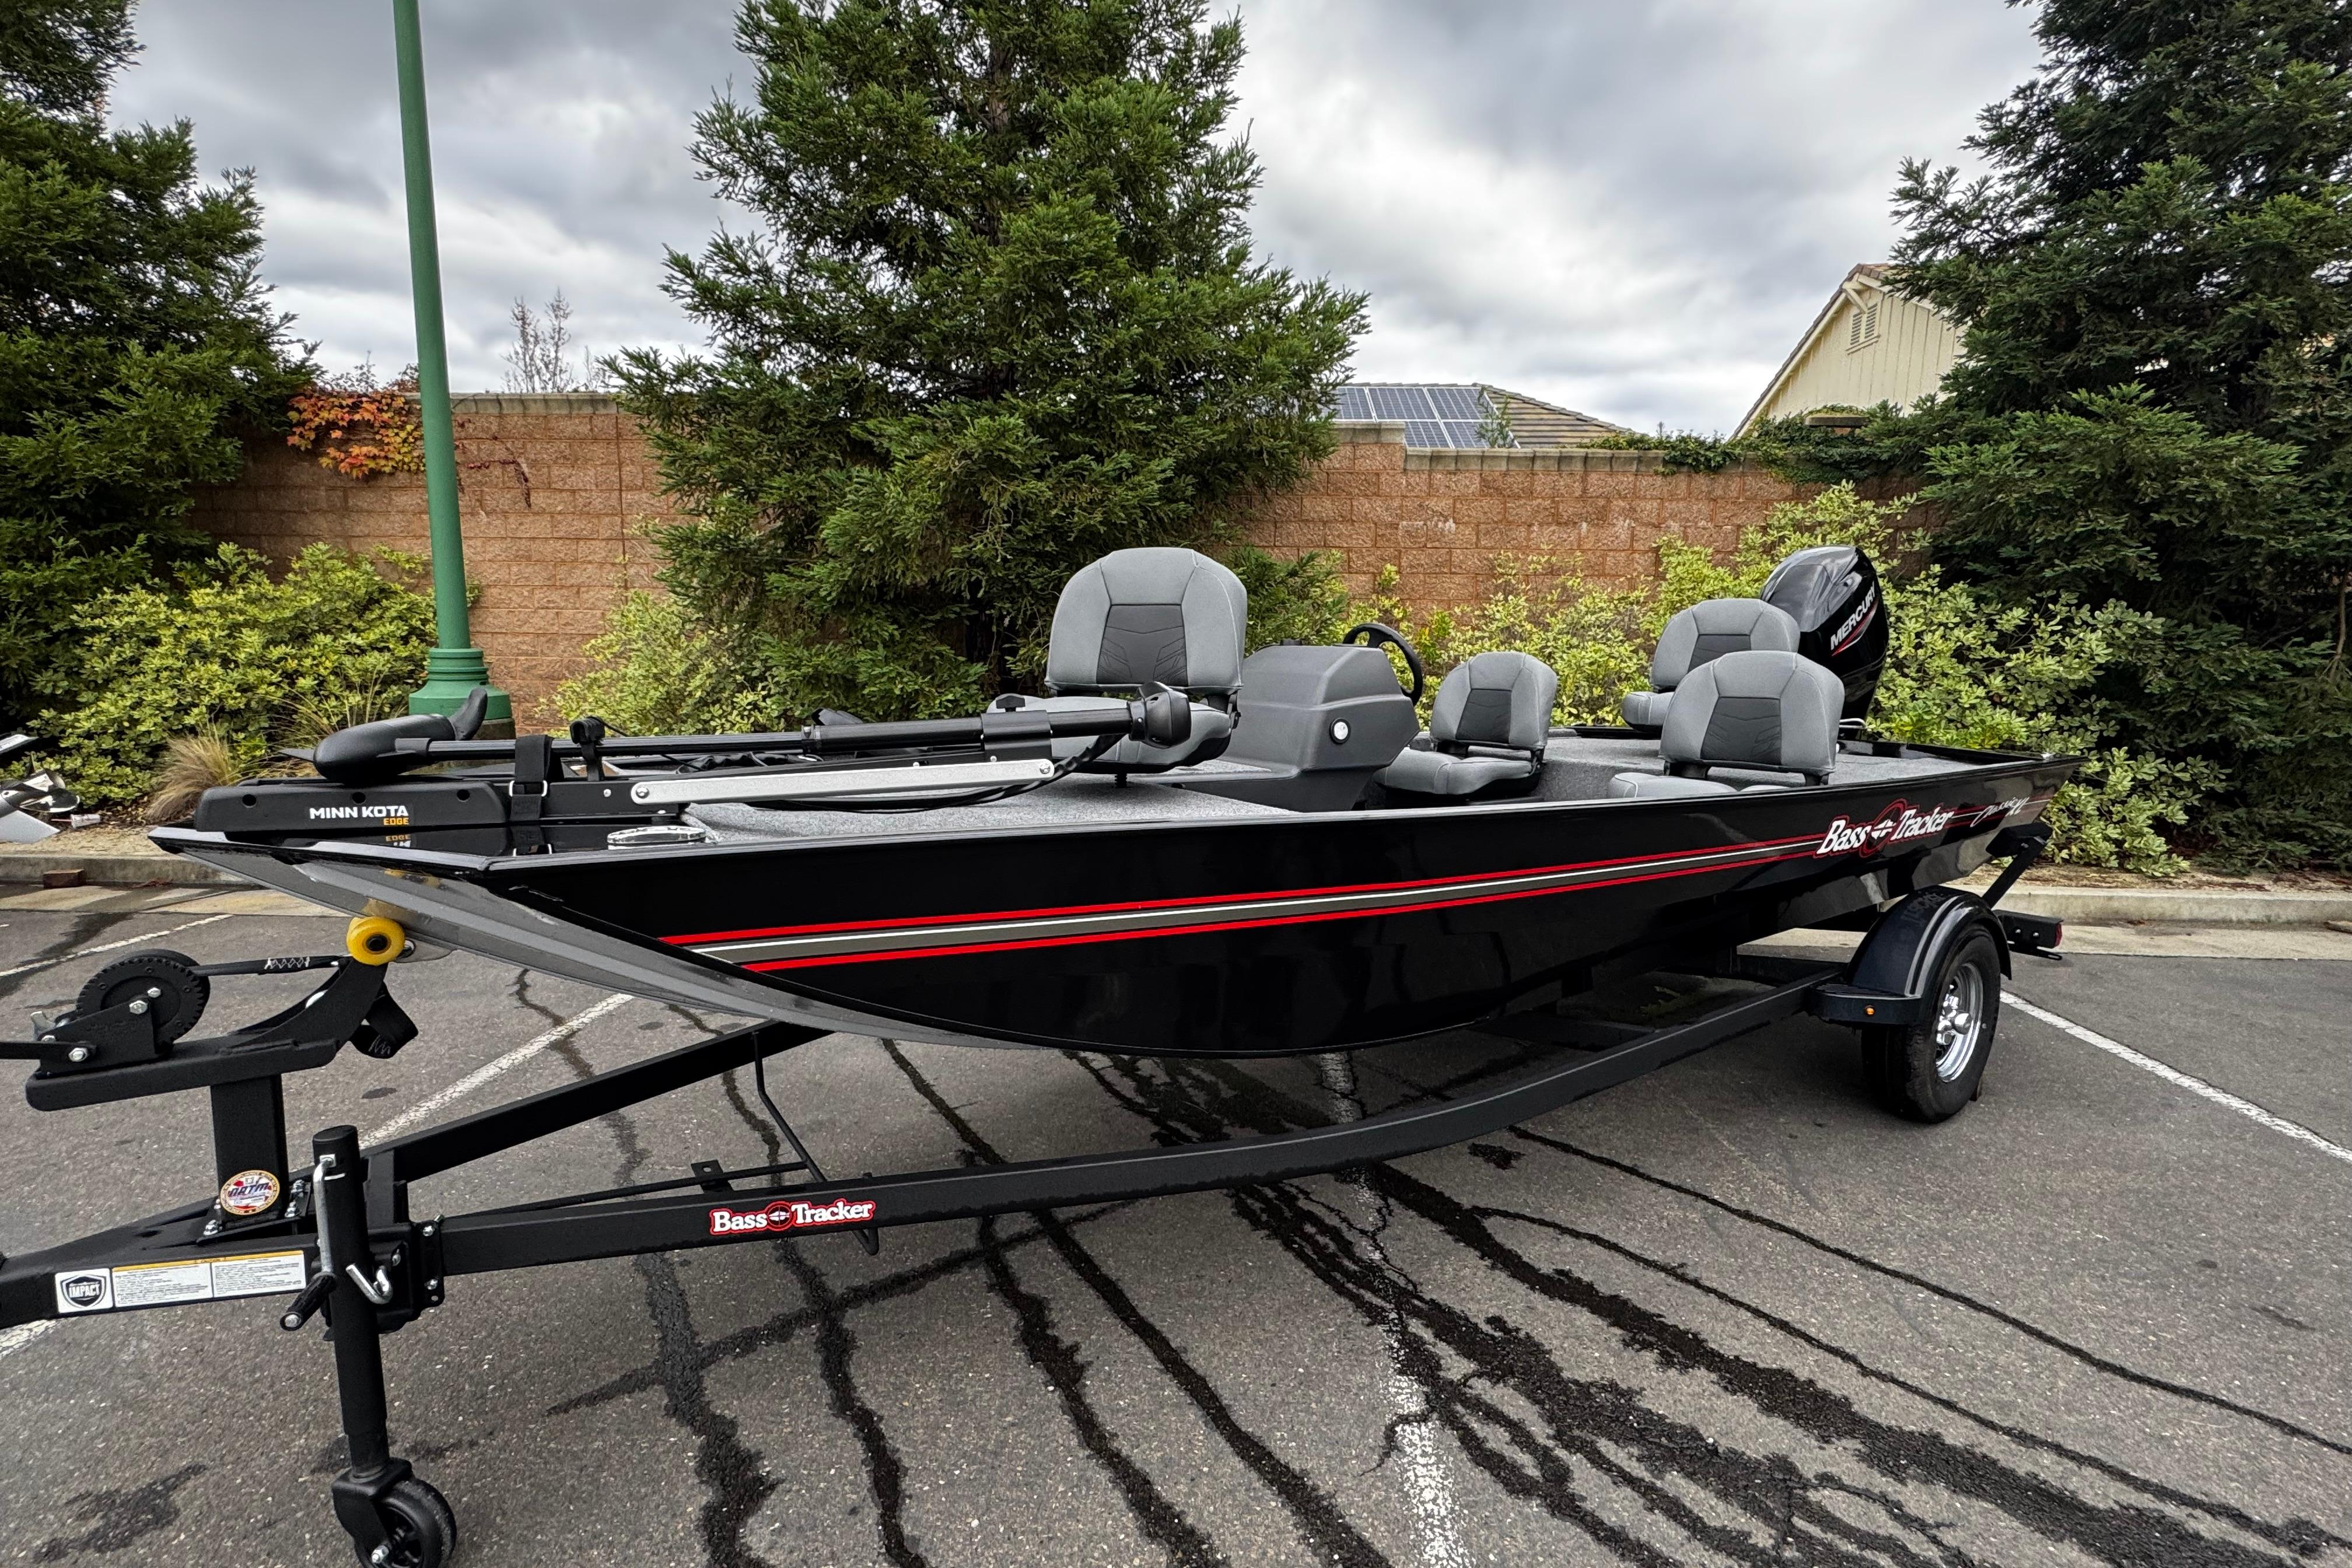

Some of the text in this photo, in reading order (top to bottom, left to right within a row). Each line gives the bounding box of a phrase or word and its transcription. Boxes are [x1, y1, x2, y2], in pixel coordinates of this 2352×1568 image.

[1831, 581, 1876, 651] MERCURY
[309, 805, 409, 820] MINN KOTA
[383, 817, 410, 826] EDGE
[1816, 819, 1871, 855] Bass
[1890, 807, 1955, 841] Tracker
[713, 1200, 873, 1232] Bass Tracker
[69, 1284, 100, 1298] IMPACT
